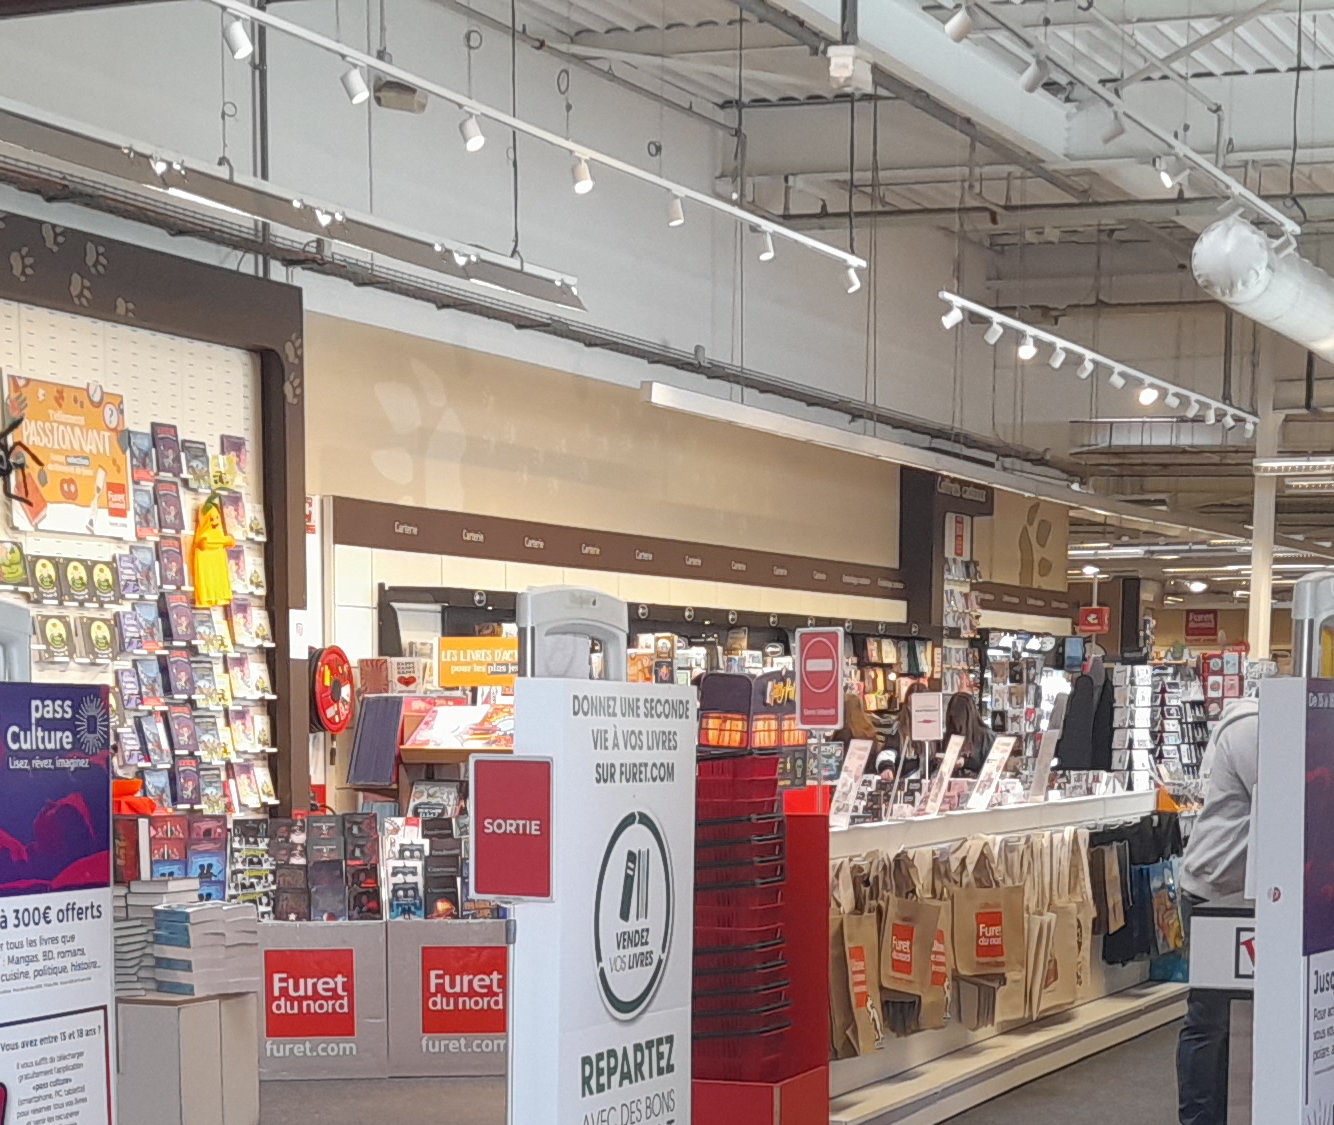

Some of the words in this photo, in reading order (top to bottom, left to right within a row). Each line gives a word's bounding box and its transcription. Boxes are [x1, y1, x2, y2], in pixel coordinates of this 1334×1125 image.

[22, 419, 111, 456] PASSIONNANT
[31, 699, 73, 724] pass
[572, 694, 617, 717] DONNEZ
[620, 698, 640, 718] UNE
[643, 698, 690, 720] SECONDE
[7, 725, 73, 750] Culture
[592, 729, 609, 750] VIE
[622, 729, 644, 751] VOS
[646, 730, 678, 751] LIVRES
[595, 762, 616, 784] SUR
[619, 761, 675, 784] FURET.COM
[483, 818, 541, 835] SORTIE
[13, 906, 52, 928] 300€
[56, 901, 103, 923] offerts
[6, 938, 24, 950] tous
[616, 928, 650, 952] VENDEZ
[627, 950, 654, 969] LIVRES
[272, 973, 348, 997] Furet
[429, 970, 503, 994] Furet
[271, 996, 299, 1014] du
[302, 994, 348, 1014] nord
[428, 993, 456, 1011] du
[458, 991, 503, 1010] nord
[266, 1039, 357, 1057] furet.com
[421, 1036, 506, 1054] furet.com
[581, 1034, 675, 1098] REPARTEZ
[620, 1099, 642, 1125] DES
[645, 1088, 676, 1119] BONS
